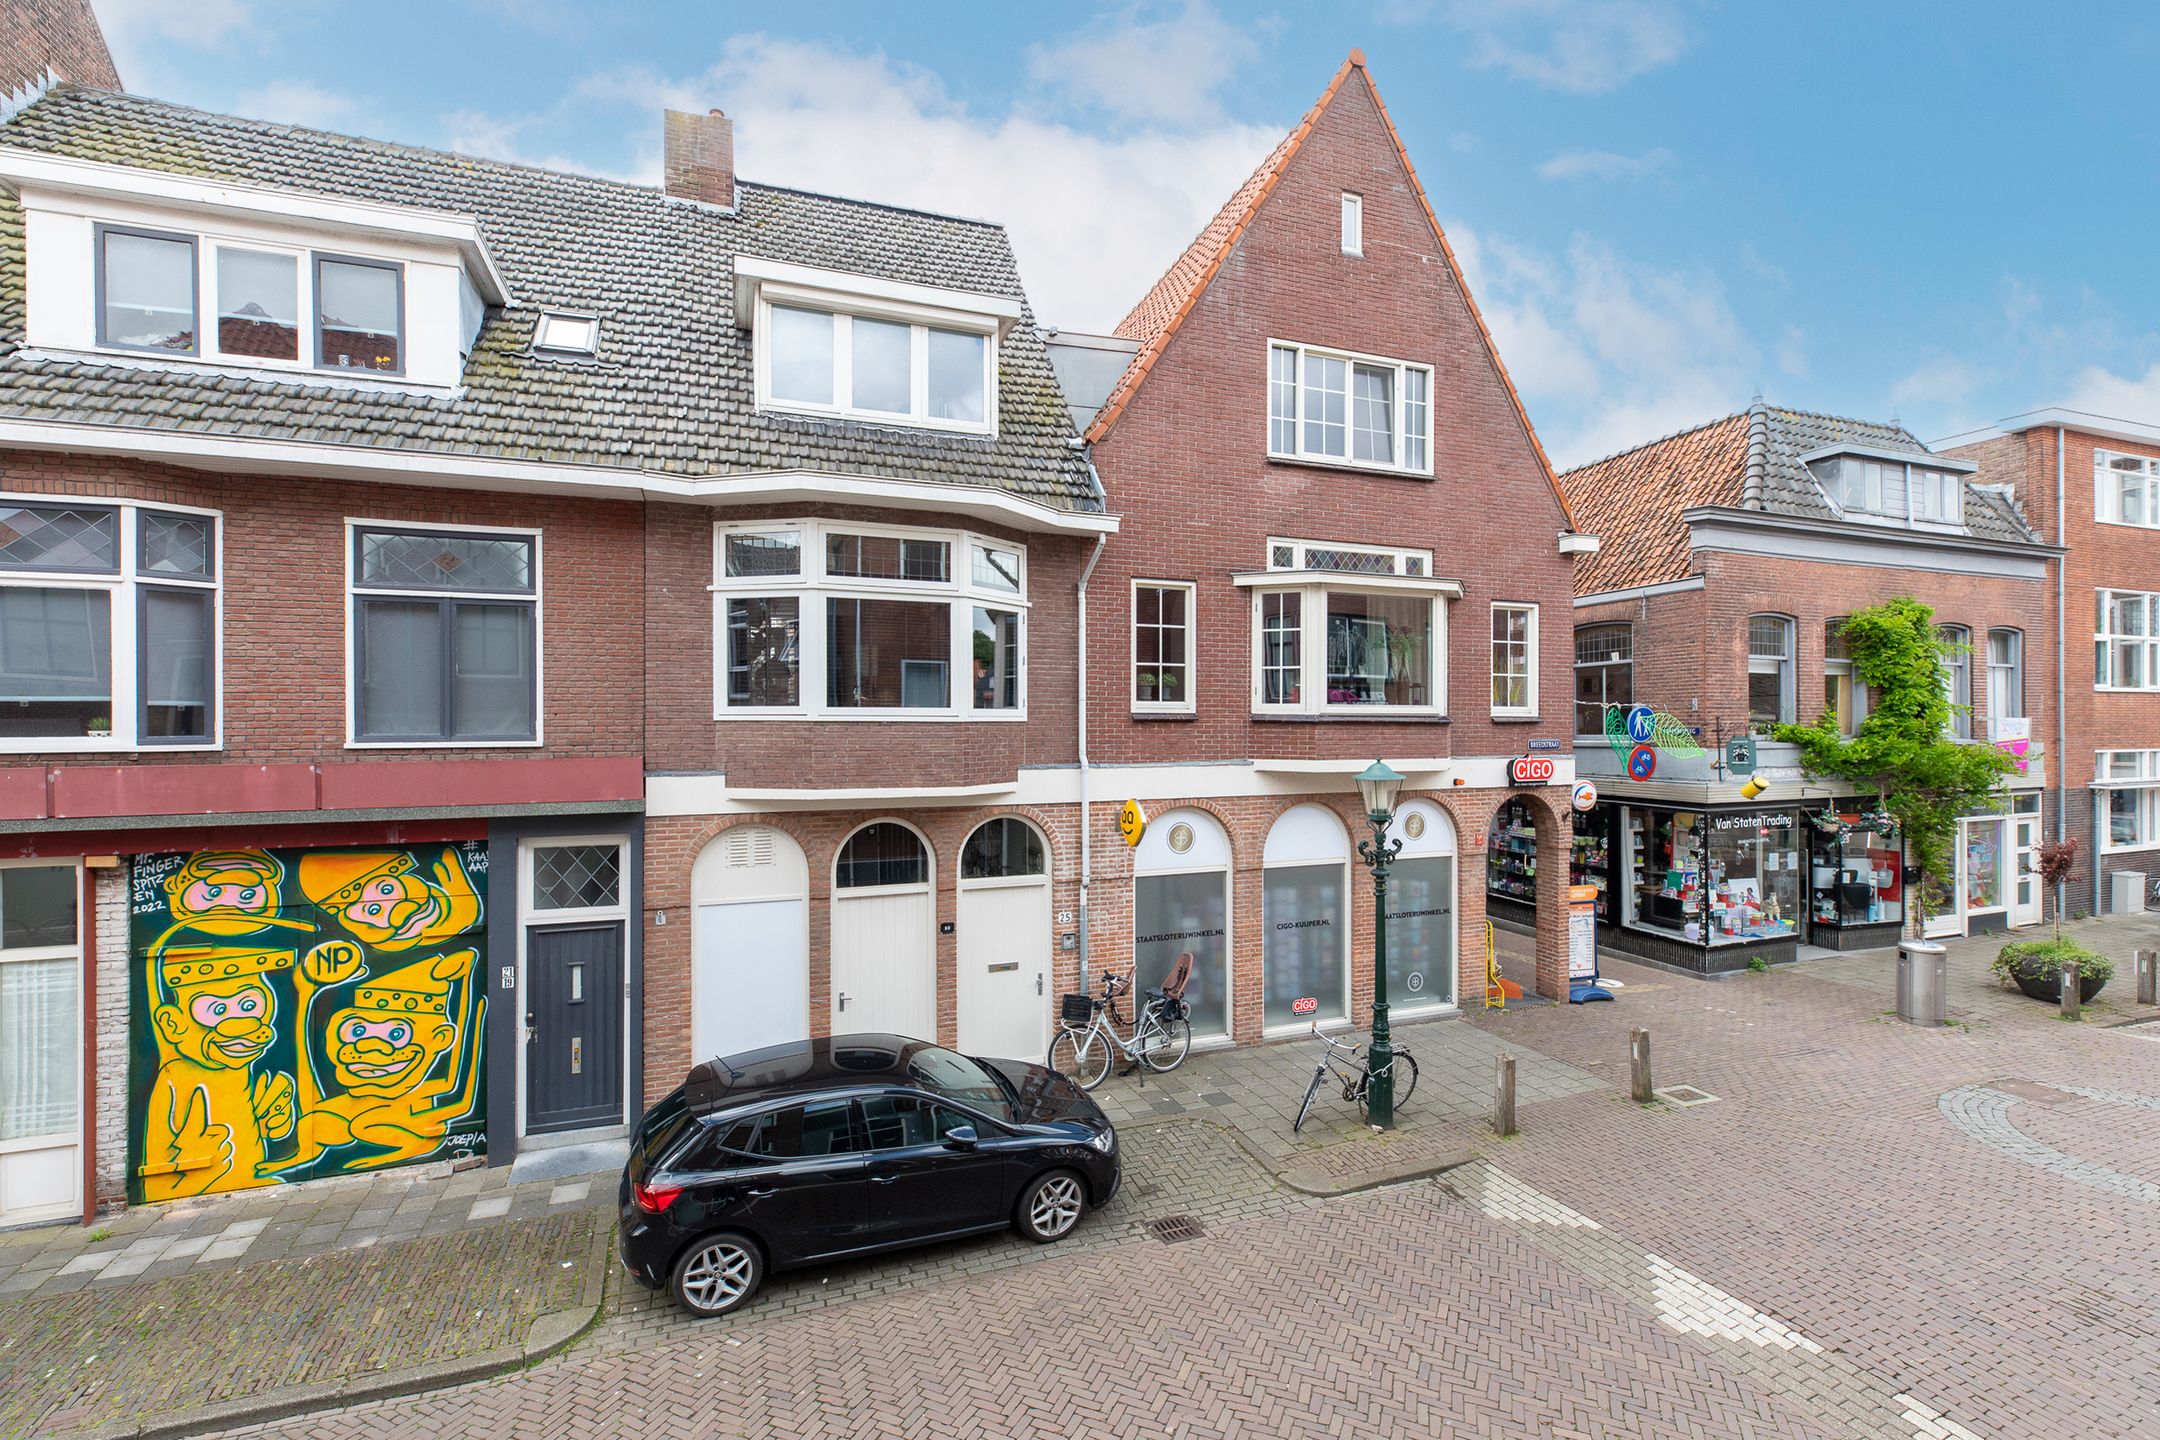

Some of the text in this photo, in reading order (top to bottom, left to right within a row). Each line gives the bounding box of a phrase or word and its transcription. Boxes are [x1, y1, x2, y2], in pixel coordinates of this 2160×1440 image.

[1516, 758, 1552, 778] CIGO
[1716, 818, 1731, 829] Van
[133, 856, 185, 878] FINGER
[468, 861, 489, 873] AAP
[133, 889, 155, 902] EN
[133, 900, 166, 914] 2022
[1060, 912, 1071, 922] 25
[1385, 908, 1451, 920] AATSLOTERIJWINKEL.NL
[316, 946, 353, 976] NP
[503, 967, 513, 976] 21
[1294, 999, 1316, 1010] CIGO
